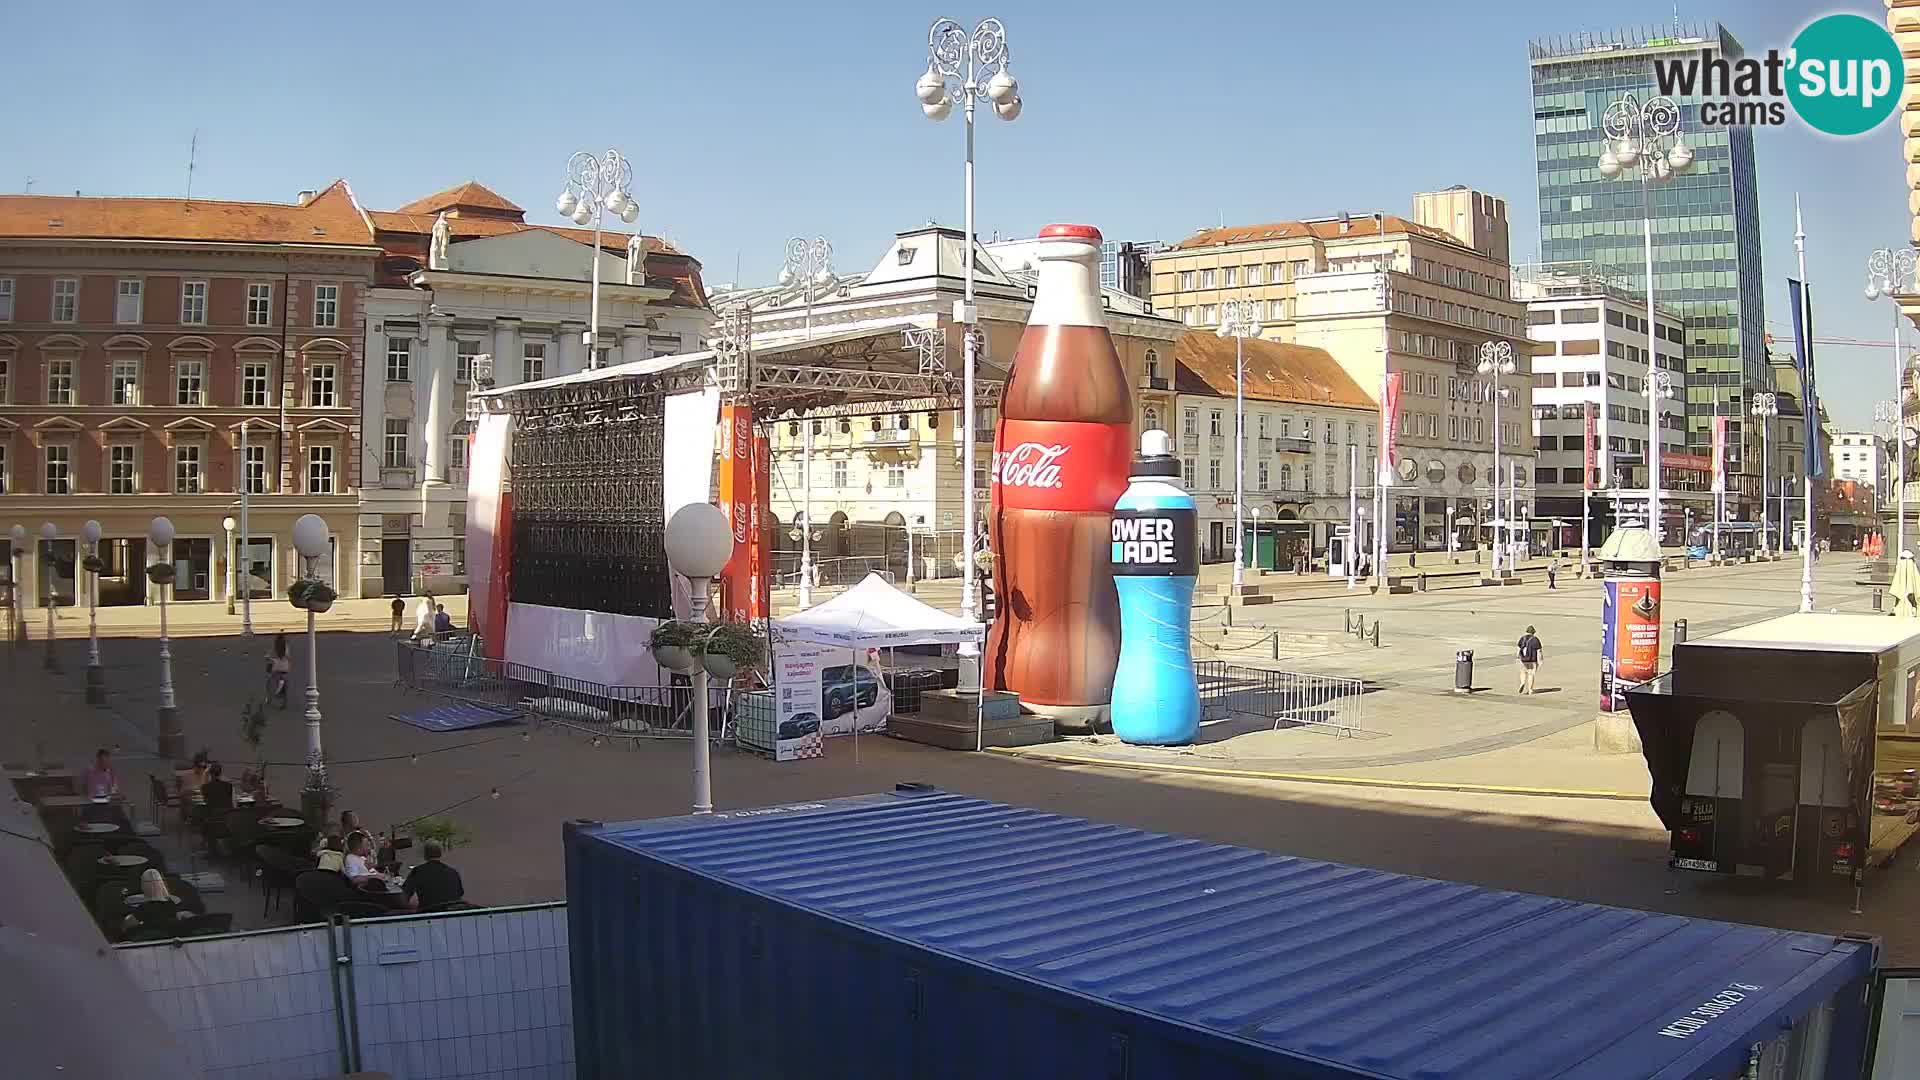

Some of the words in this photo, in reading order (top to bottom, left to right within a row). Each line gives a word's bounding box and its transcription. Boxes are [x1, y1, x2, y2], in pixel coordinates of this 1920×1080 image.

[735, 416, 747, 459] Coca-Cola
[735, 501, 747, 543] Coca-Cola
[1112, 518, 1174, 541] OWER
[1658, 1016, 1708, 1038] MCDU
[1691, 990, 1747, 1018] 300629
